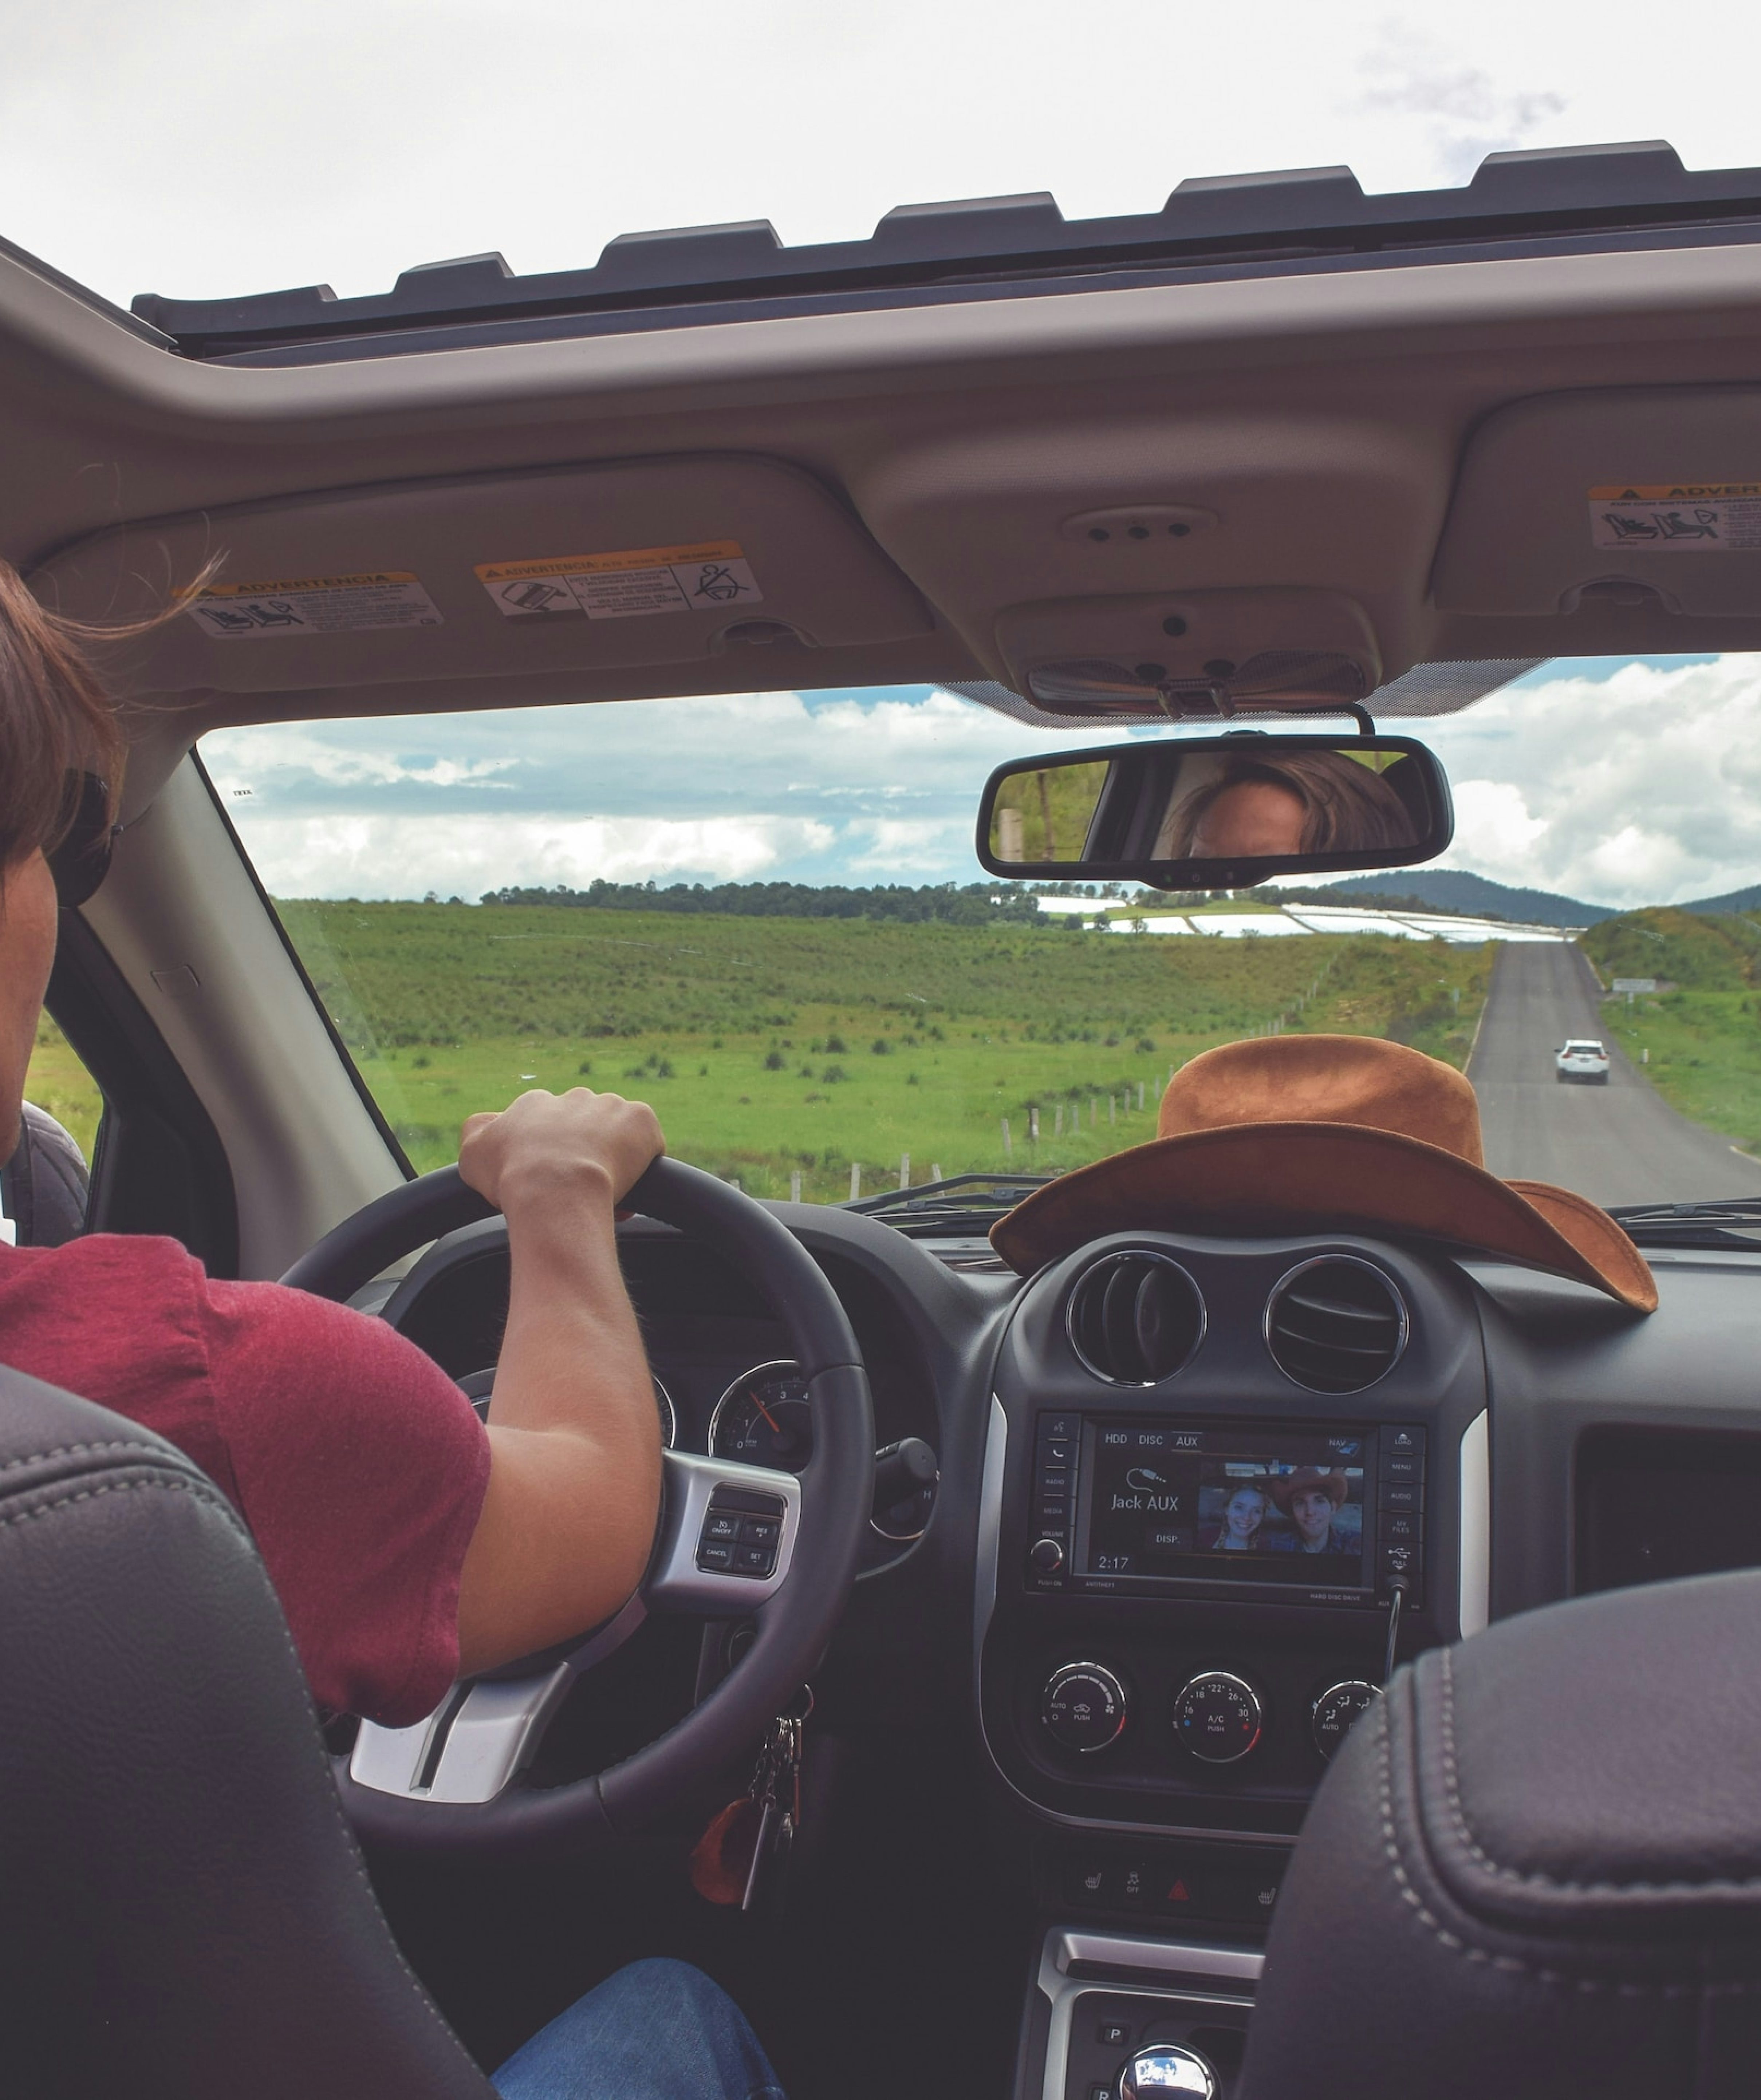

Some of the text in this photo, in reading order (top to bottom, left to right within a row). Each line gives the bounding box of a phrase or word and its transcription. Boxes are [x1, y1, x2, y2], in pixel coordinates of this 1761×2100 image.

[238, 575, 390, 593] ADVERTENCIA
[780, 1391, 786, 1399] 3
[1105, 1433, 1198, 1446] HDD DISC AUX
[737, 1441, 743, 1449] 0
[923, 1491, 931, 1499] H
[1111, 1494, 1179, 1511] Jack AUX
[1157, 1535, 1180, 1544] DISP.
[1098, 1556, 1129, 1569] 2:17
[1195, 1690, 1205, 1699] 18
[1228, 1693, 1238, 1701] 26
[1185, 1706, 1193, 1714] 16
[1238, 1709, 1249, 1717] 30
[1208, 1715, 1224, 1724] A/C
[1111, 2029, 1120, 2039] P
[1099, 2092, 1109, 2100] R
